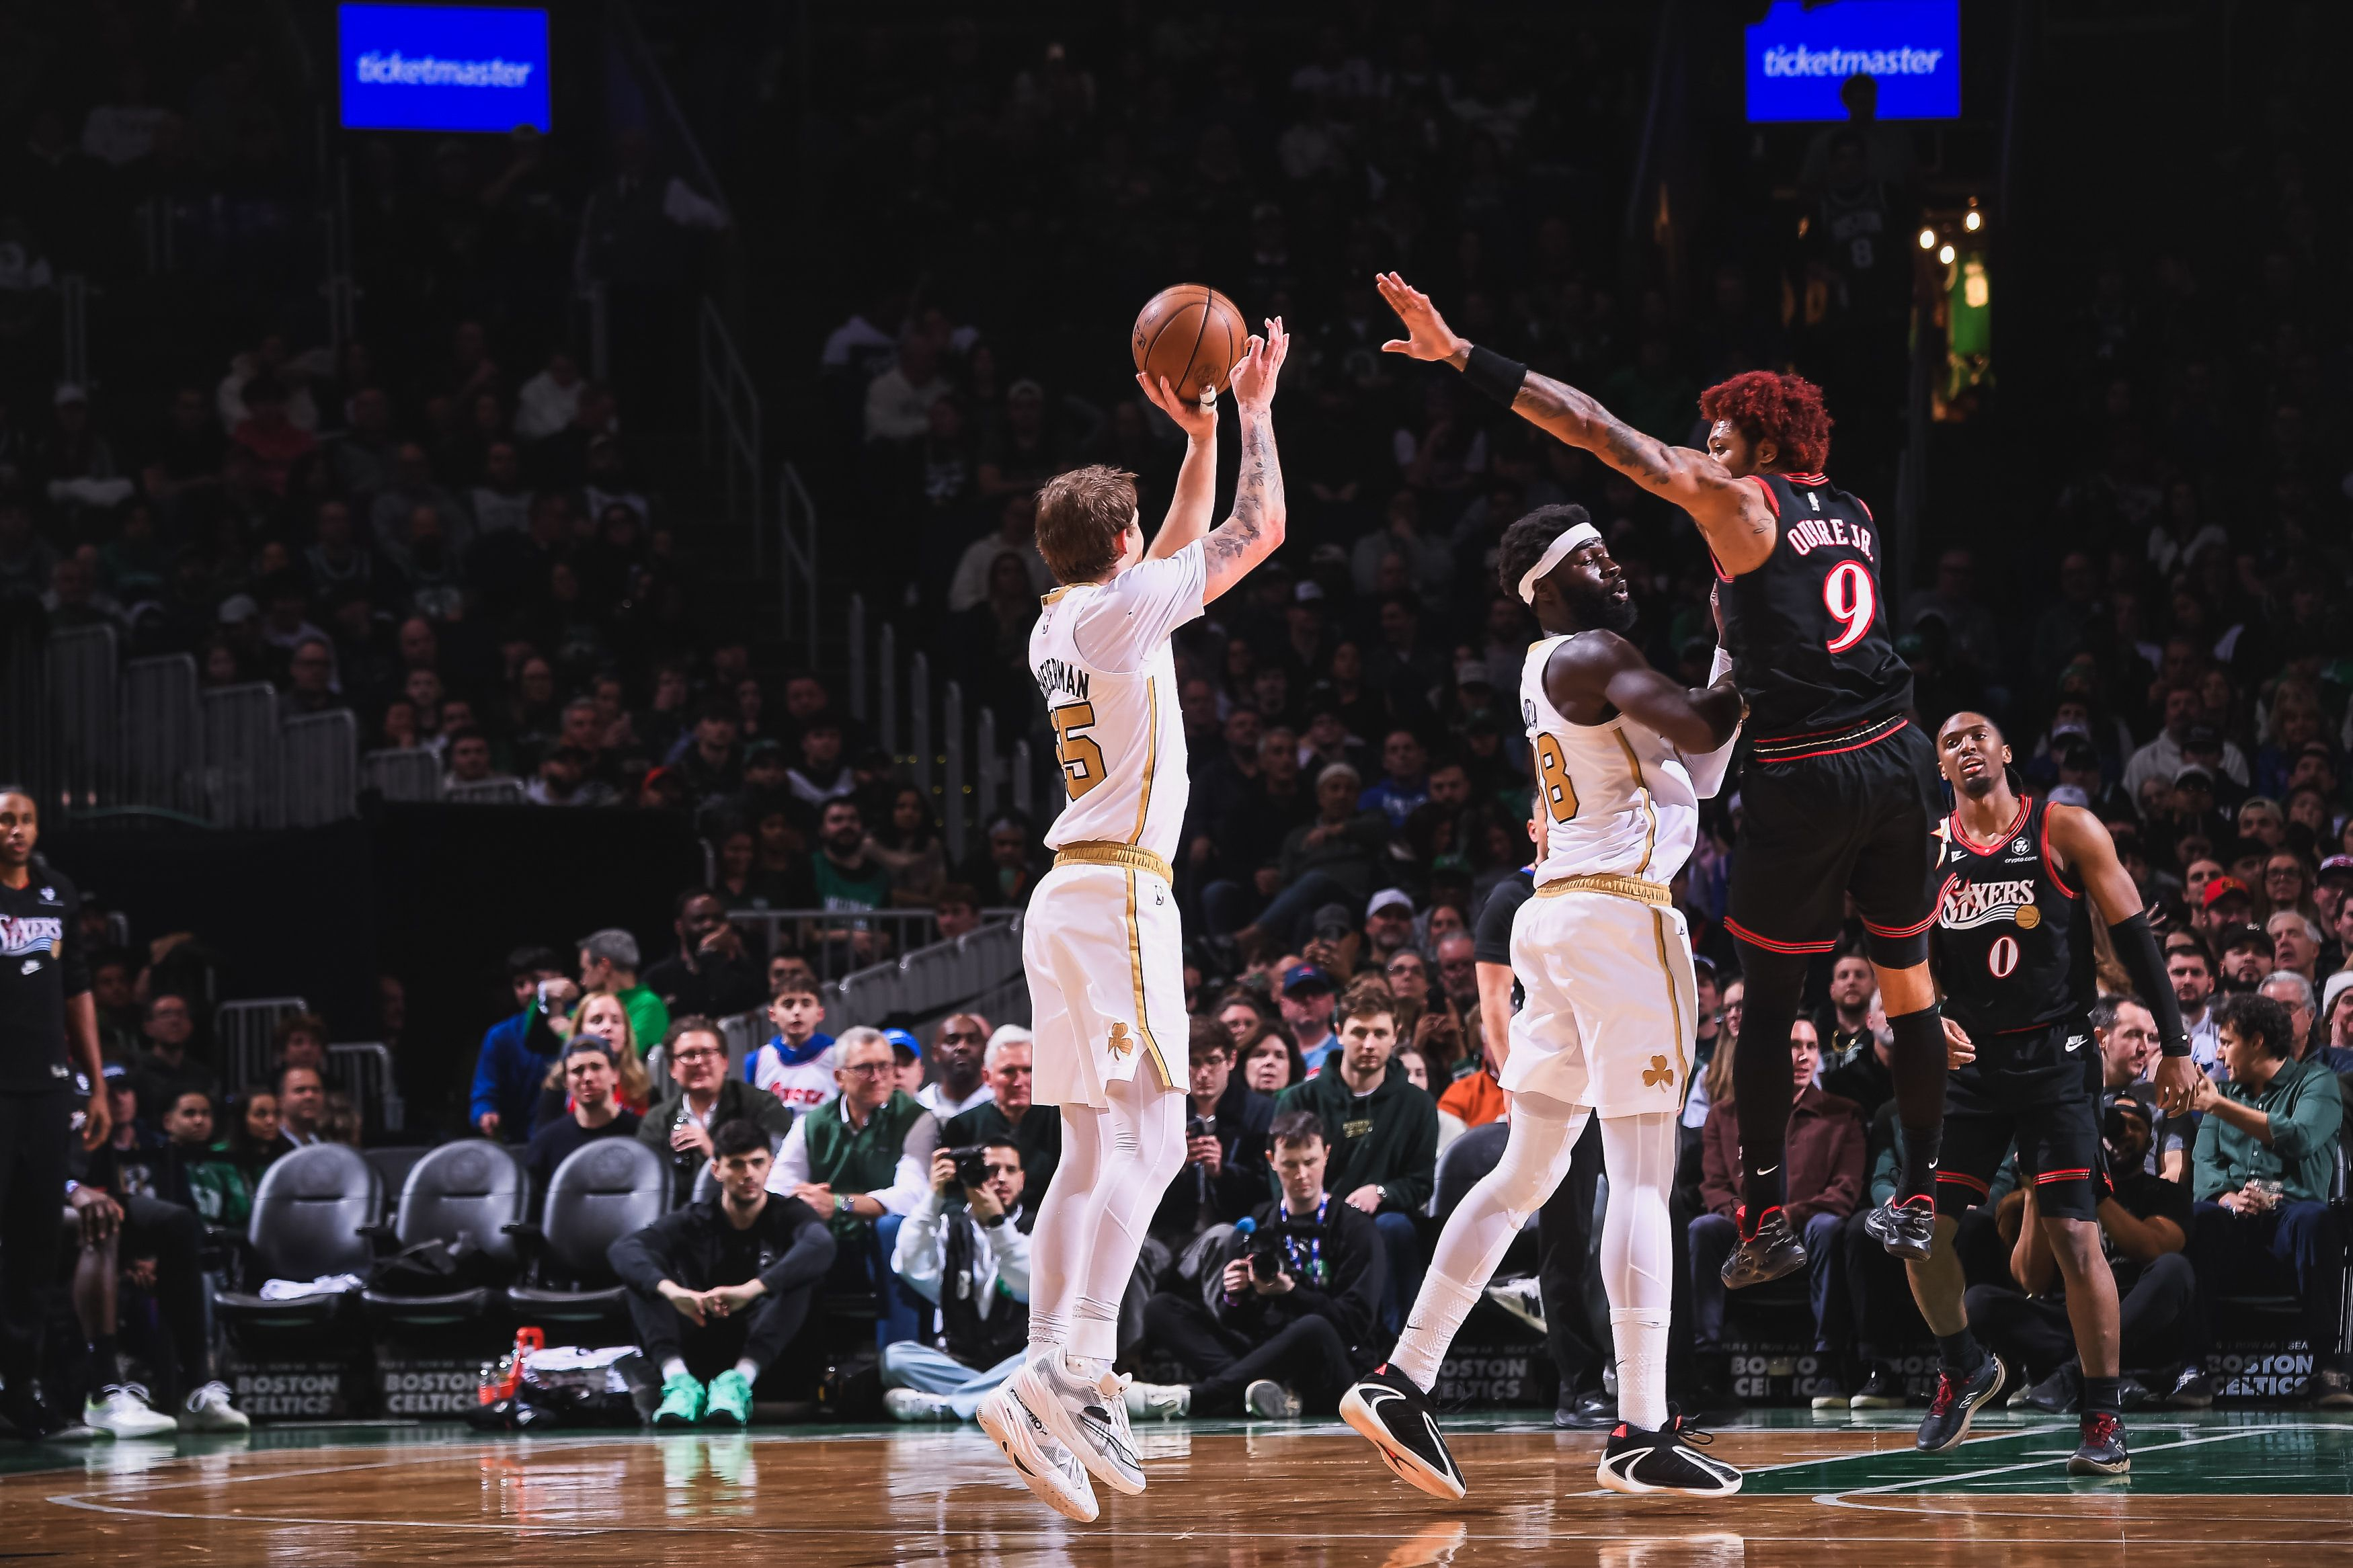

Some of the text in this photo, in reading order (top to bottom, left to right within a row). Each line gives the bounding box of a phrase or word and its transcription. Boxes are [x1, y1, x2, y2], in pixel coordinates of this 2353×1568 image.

[357, 49, 534, 87] ticketmaster
[1763, 43, 1943, 77] ticketmaster
[1850, 522, 1874, 563] JR.
[1823, 559, 1876, 654] 9
[1533, 731, 1580, 825] 8
[2004, 856, 2038, 864] crypto.com
[1988, 935, 2020, 979] 0
[2288, 1339, 2309, 1350] SEA
[1440, 1358, 1528, 1378] OSTON
[2206, 1354, 2314, 1375] BOSTON
[236, 1375, 340, 1394] BOSTON
[1442, 1380, 1521, 1399] ELTICS
[2211, 1376, 2309, 1397] CELTICS
[239, 1396, 333, 1415] CELTICS
